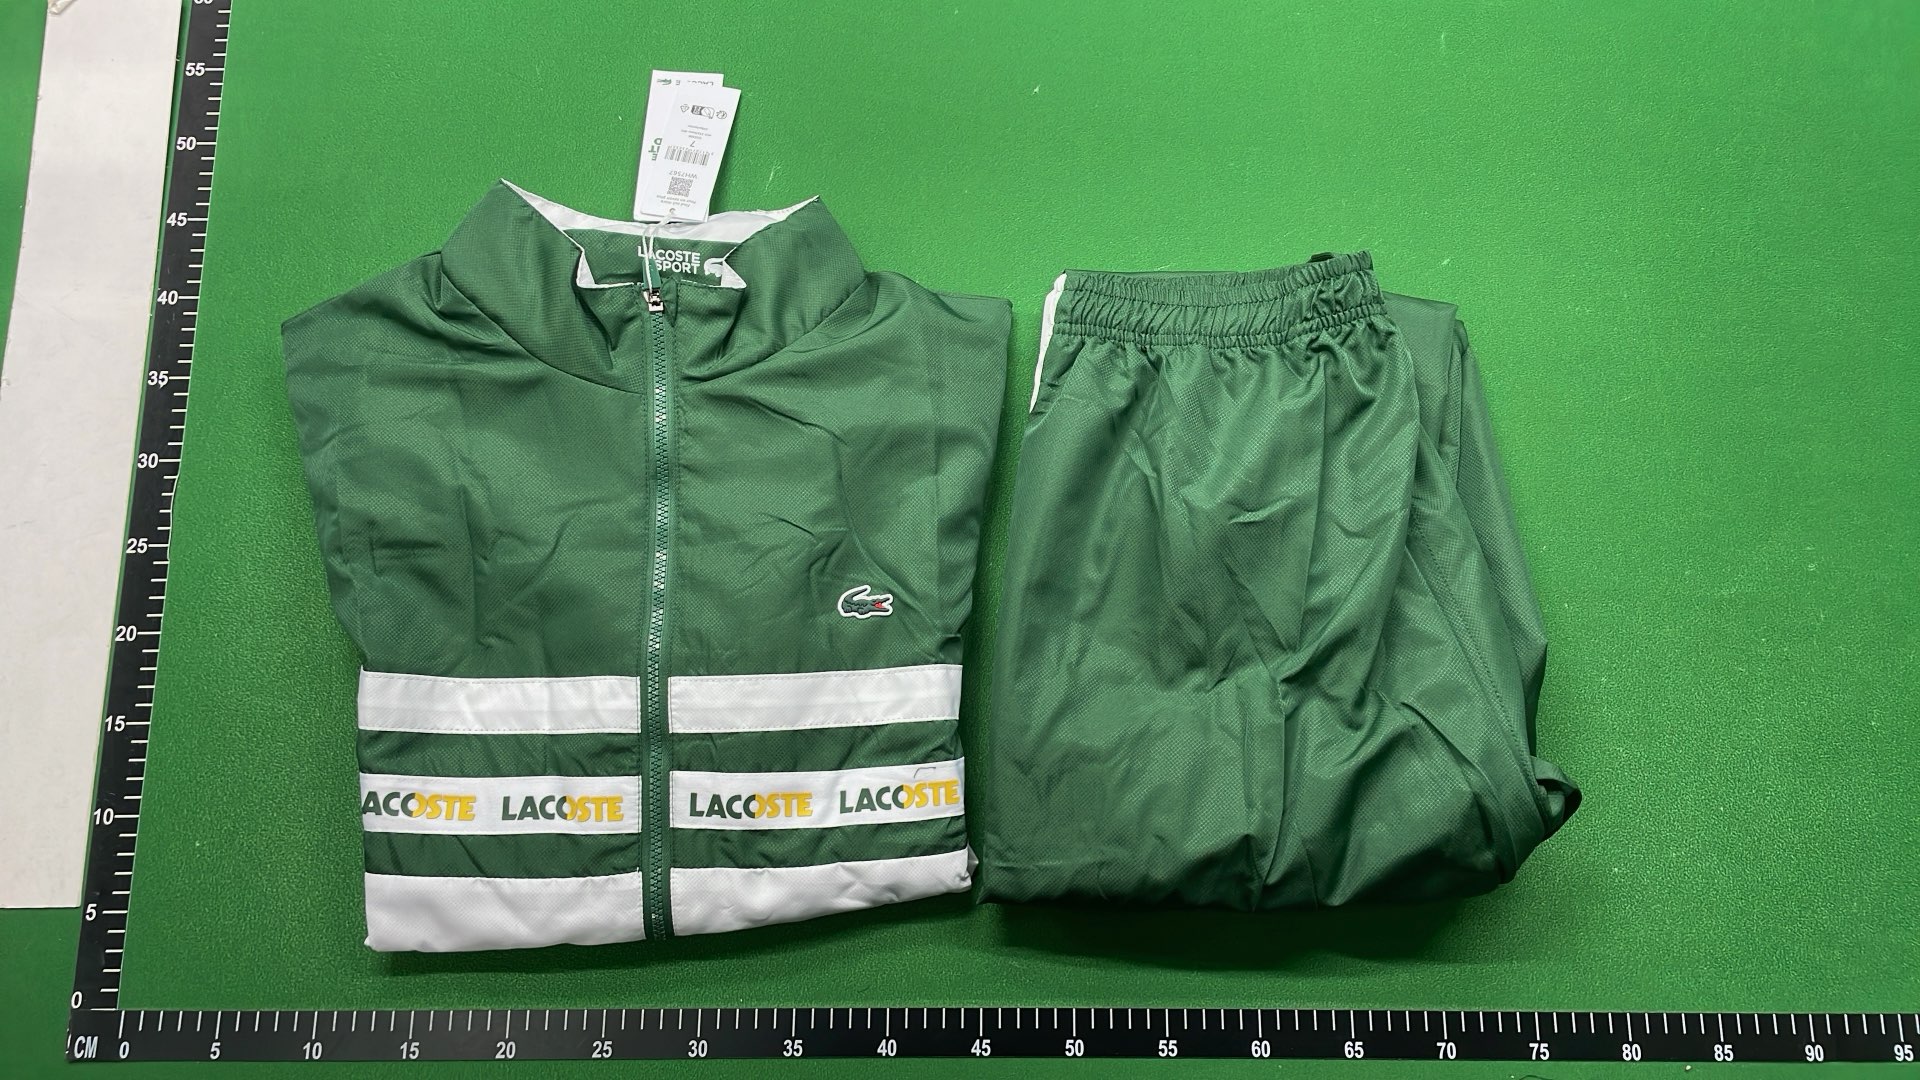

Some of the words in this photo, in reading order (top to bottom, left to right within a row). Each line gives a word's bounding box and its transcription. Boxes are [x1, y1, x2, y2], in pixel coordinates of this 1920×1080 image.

[185, 62, 206, 77] 55
[175, 136, 197, 151] 50
[166, 212, 188, 227] 45
[655, 261, 701, 275] SPORT
[157, 290, 179, 306] 40
[147, 371, 169, 386] 35
[136, 452, 159, 469] 30
[125, 537, 148, 554] 25
[114, 625, 138, 642] 20
[104, 715, 126, 732] 15
[361, 791, 476, 821] ACOSTE
[501, 795, 624, 822] LACOSTE
[689, 792, 813, 819] LACOSTE
[840, 779, 960, 814] LACOSTE
[93, 808, 114, 826] 10
[85, 903, 97, 922] 5
[70, 990, 83, 1010] 0
[74, 1036, 98, 1058] CM
[119, 1041, 130, 1059] 0
[210, 1042, 220, 1059] 5
[303, 1042, 322, 1059] 10
[400, 1042, 420, 1059] 15
[495, 1041, 516, 1059] 20
[592, 1041, 613, 1058] 25
[687, 1040, 708, 1057] 30
[782, 1040, 803, 1057] 35
[876, 1039, 897, 1056] 40
[970, 1039, 991, 1056] 45
[1064, 1040, 1085, 1057] 50
[1158, 1040, 1178, 1057] 55
[1251, 1041, 1271, 1057] 60
[1344, 1041, 1365, 1058] 65
[1436, 1042, 1457, 1059] 70
[1529, 1043, 1549, 1060] 75
[1622, 1044, 1642, 1061] 80
[1713, 1044, 1734, 1062] 85
[1804, 1045, 1825, 1062] 90
[1893, 1045, 1914, 1062] 95
